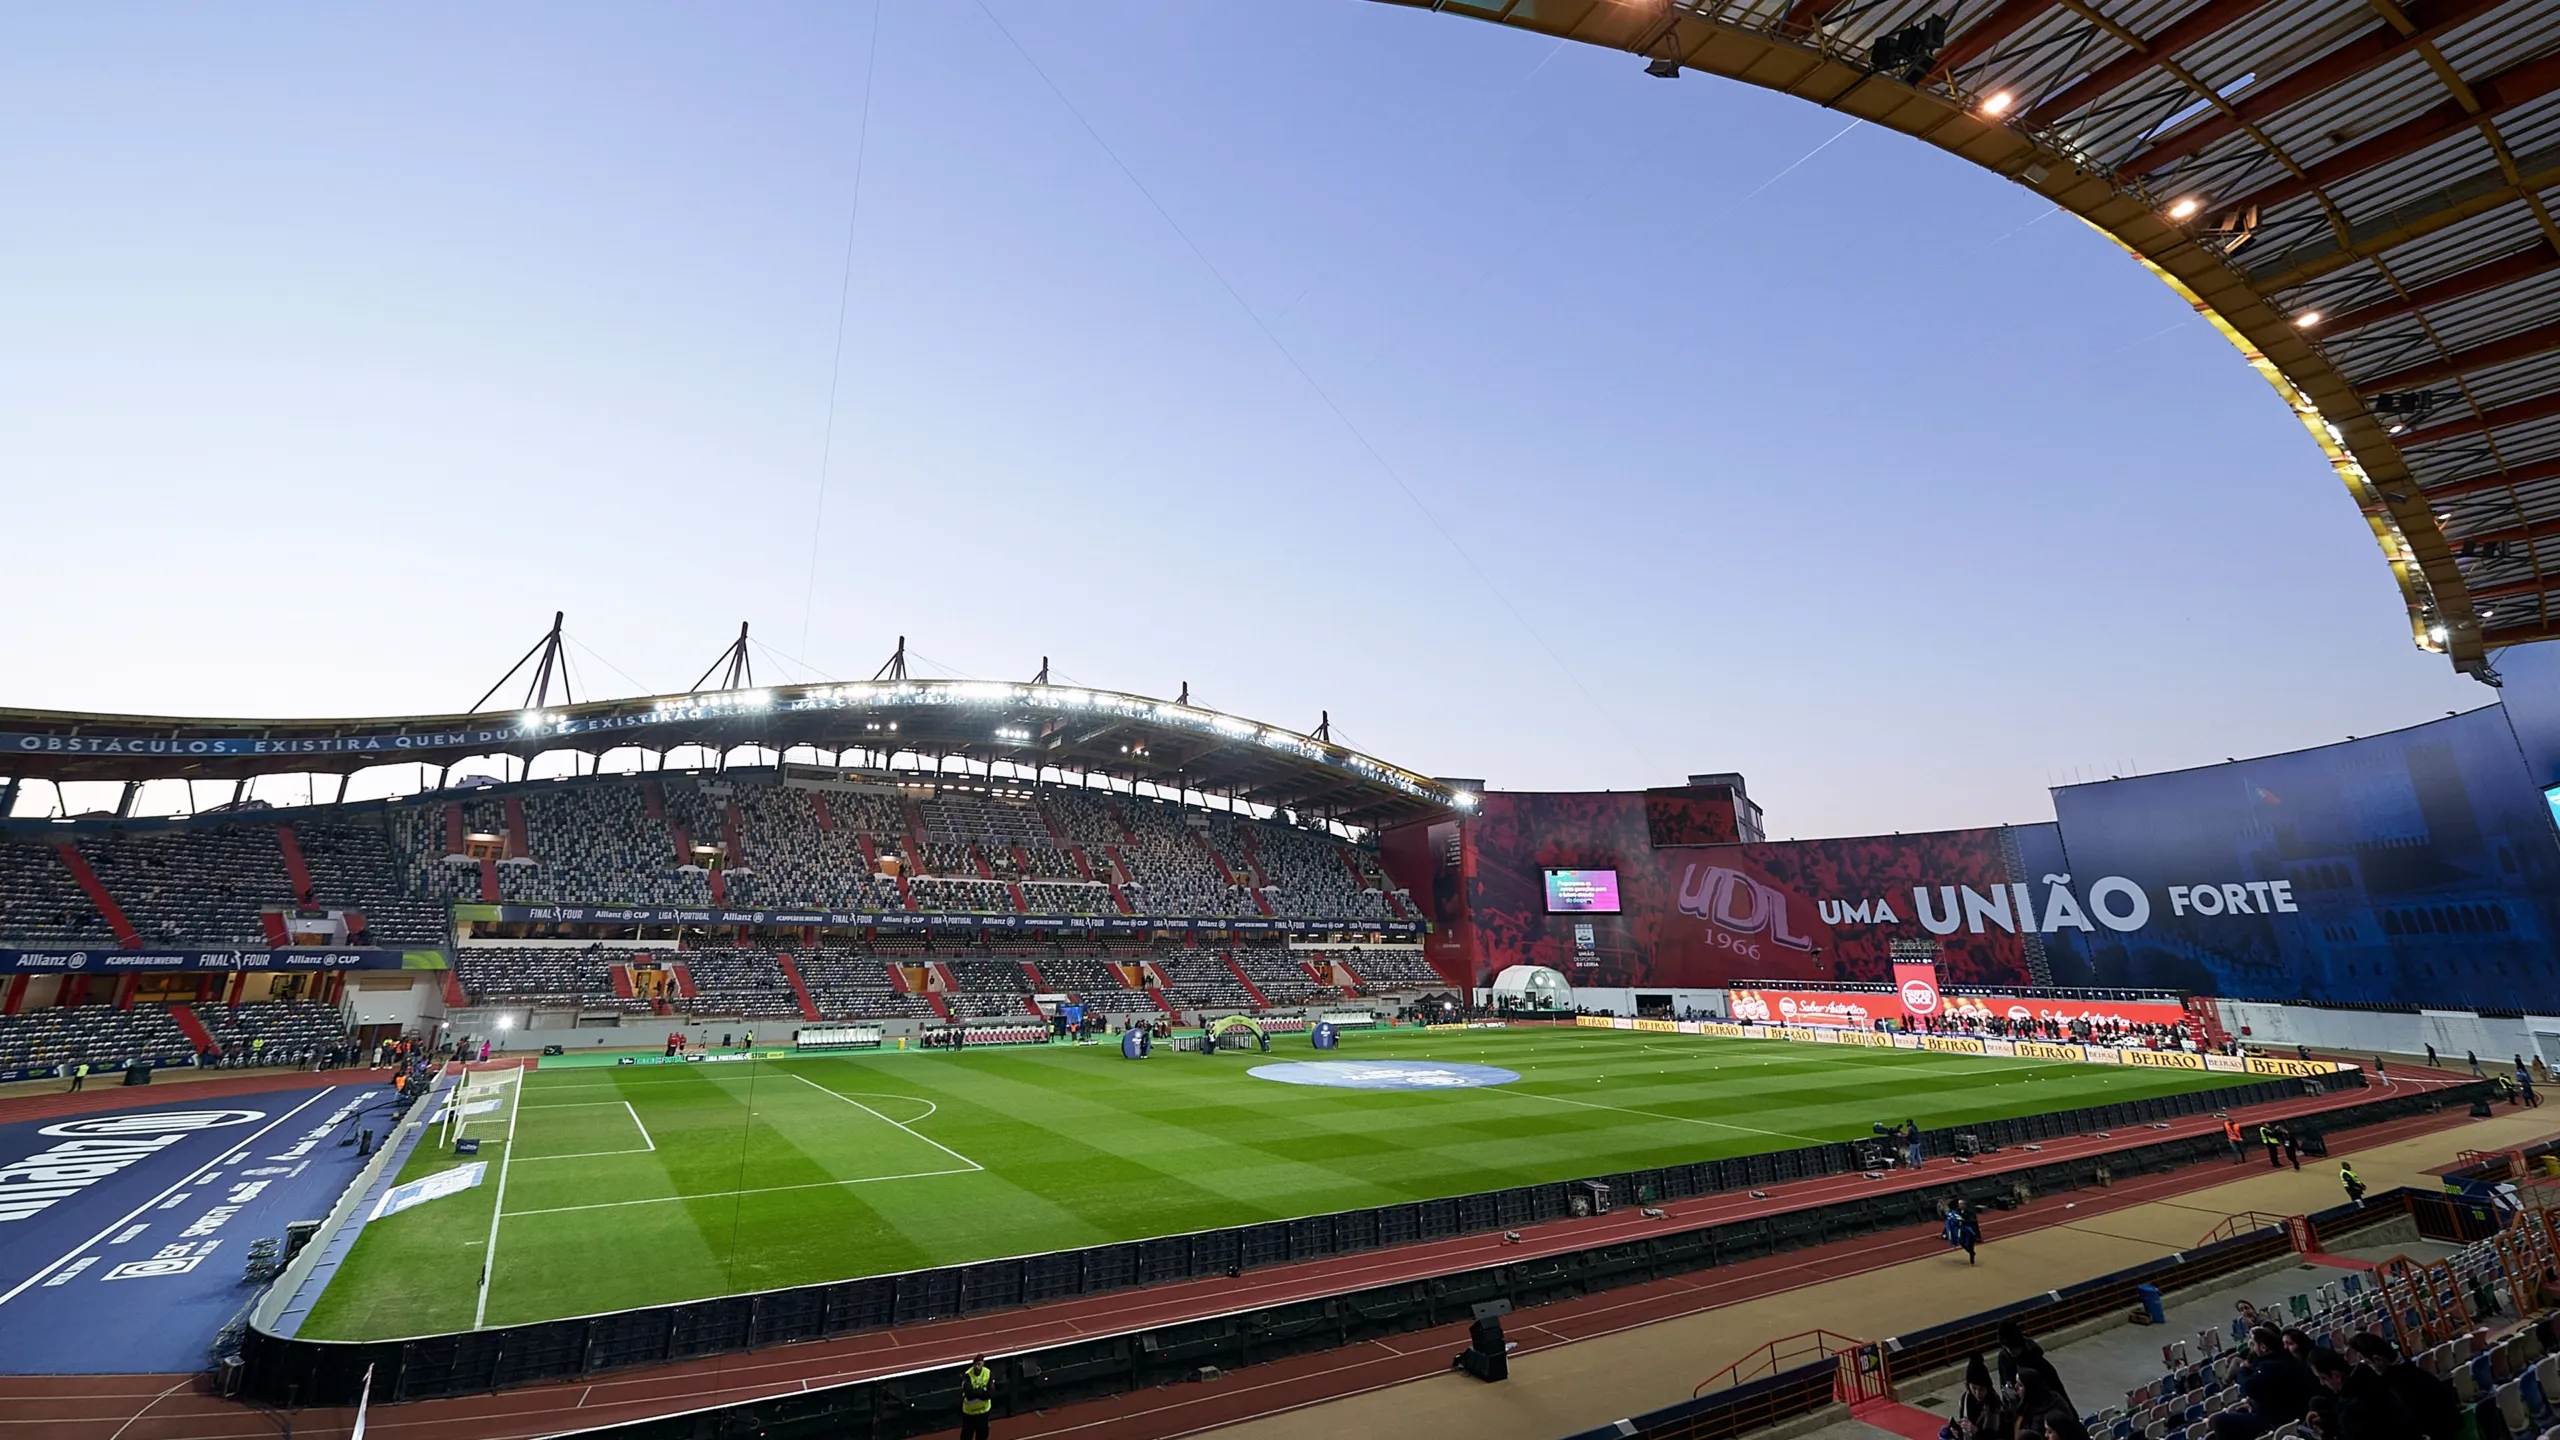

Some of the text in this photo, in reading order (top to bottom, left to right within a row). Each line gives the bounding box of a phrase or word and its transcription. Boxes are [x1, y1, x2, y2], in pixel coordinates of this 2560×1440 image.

[20, 736, 238, 754] OBSTÁCULOS.
[254, 736, 381, 753] EXISTIRÁ
[395, 733, 465, 749] QUEM
[480, 722, 577, 741] DUVIDE.
[791, 700, 828, 711] MAS
[1418, 787, 1454, 807] LEIRIA
[1818, 873, 2299, 935] UMA UNIÃO FORTE
[530, 908, 583, 920] FINAL FOUR
[595, 910, 650, 919] Allianz CUP
[658, 911, 710, 921] LIGA PORTUGAL
[722, 912, 753, 921] Allianz
[832, 914, 873, 924] FINAL FOUR
[931, 917, 972, 925] LIGA PORTUGAL
[982, 917, 1006, 925] Allianz
[1071, 918, 1105, 927] FINAL FOUR
[1197, 920, 1218, 928] Allianz
[1275, 921, 1287, 929] FINAL
[1389, 922, 1408, 930] Allianz
[1704, 928, 1761, 961] 1966
[16, 953, 67, 966] Allianz
[199, 953, 271, 966] FINAL FOUR
[286, 954, 360, 964] Allianz CUP
[1904, 989, 1932, 999] SUPER
[1907, 996, 1932, 1005] BOCK
[1577, 1016, 1609, 1028] BEIRÃO
[1638, 1020, 1675, 1032] BEIRÃO
[1704, 1023, 1739, 1036] BEIRÃO
[1771, 1026, 1812, 1041] BERÃO
[1928, 1037, 1978, 1053] BEIRÃO
[2020, 1044, 2076, 1060] BEIRÃO
[2088, 1051, 2119, 1061] BEIRÃO
[2131, 1051, 2197, 1070] BEIRÃO
[2208, 1058, 2242, 1069] BEIRÃO
[2254, 1059, 2327, 1076] BEIRÃO
[0, 1133, 189, 1222] ianz
